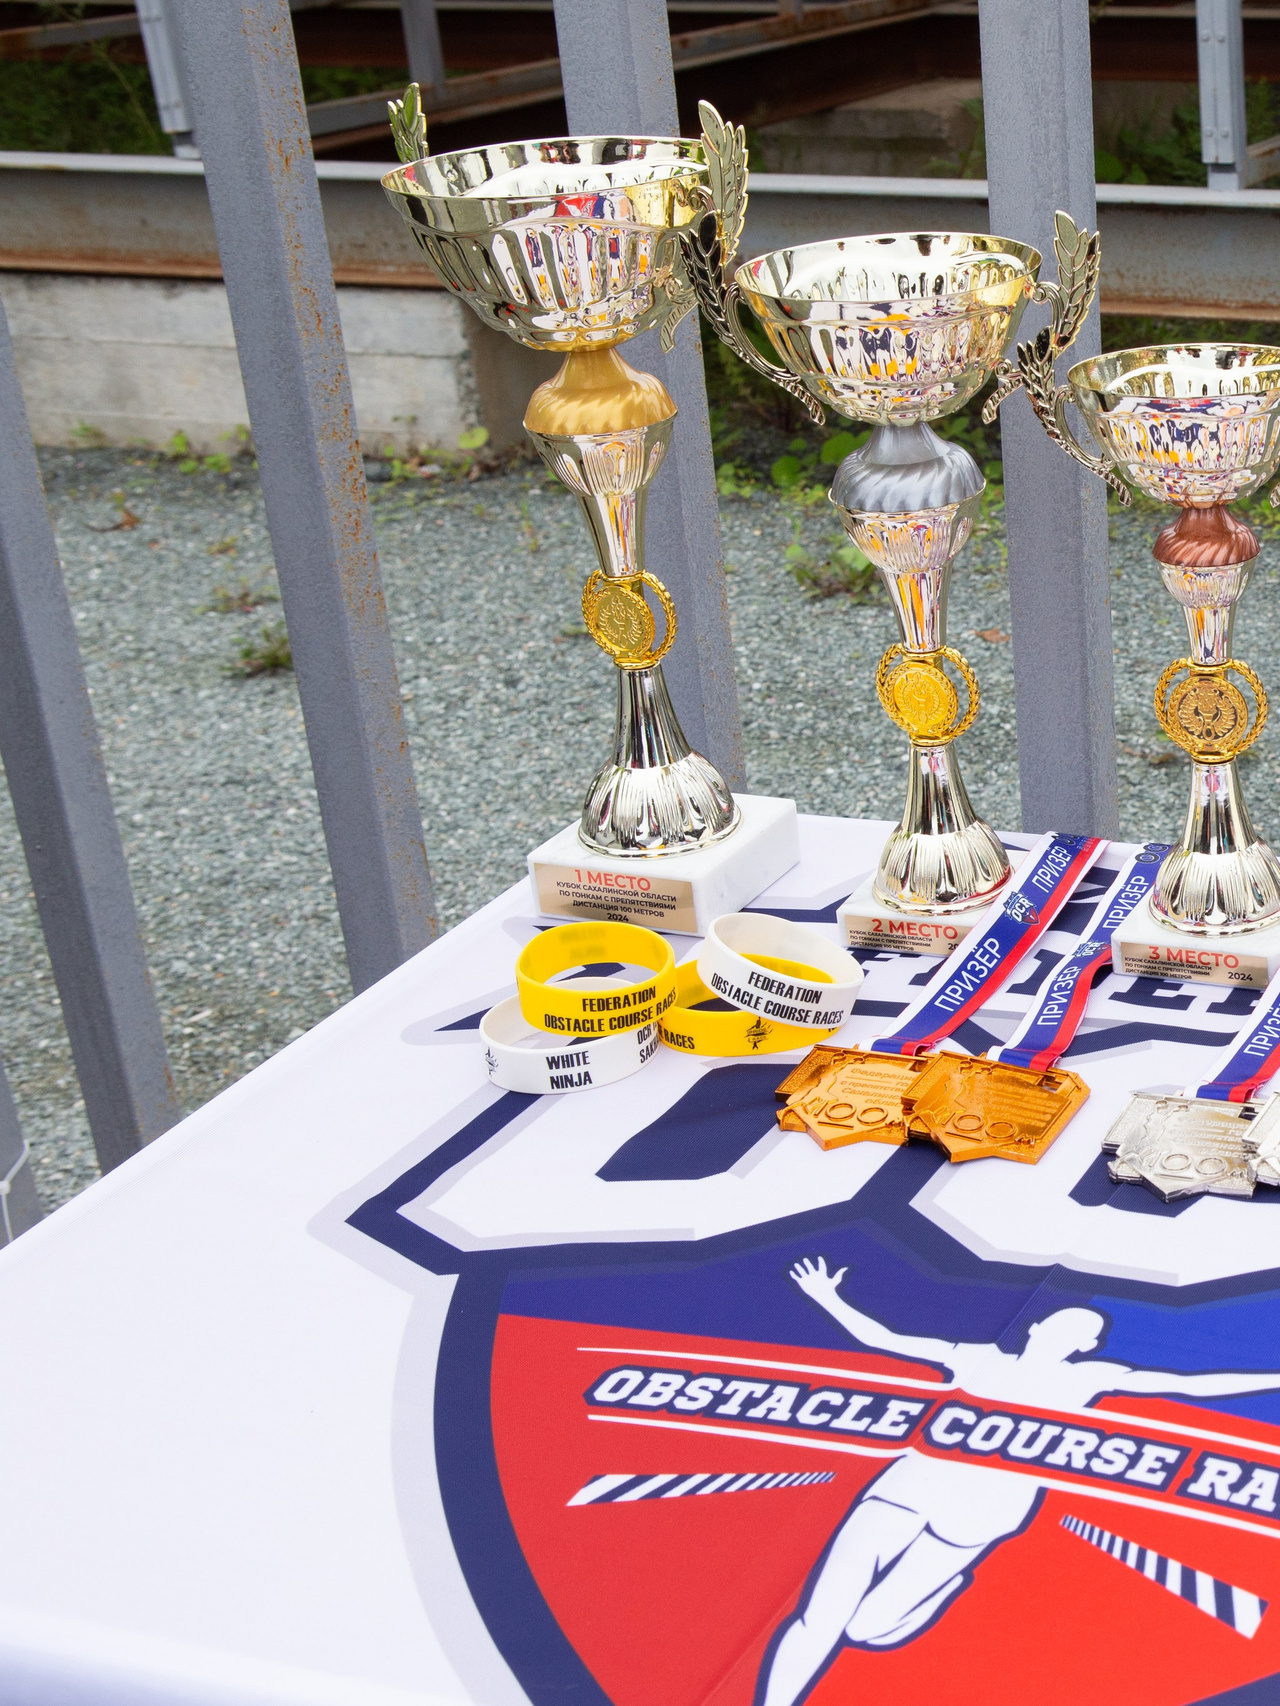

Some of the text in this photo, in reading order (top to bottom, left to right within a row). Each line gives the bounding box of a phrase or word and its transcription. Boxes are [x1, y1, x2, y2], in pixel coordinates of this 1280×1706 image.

[574, 869, 651, 891] 1 МЕСТО
[1032, 845, 1072, 893] ПРИЗЁР
[556, 881, 677, 902] КУБОК САХАЛИНСКОЙ ОБЛАСТИ
[559, 889, 570, 897] ПО
[572, 891, 603, 901] ГОНКАМ
[611, 896, 676, 910] ПРЕПЯТСТВИЯМИ
[1102, 875, 1149, 929] ПРИЗЁР
[572, 900, 665, 918] ДИСТАНЦИЯ 100 МЕТРОВ
[607, 913, 629, 922] 2024
[1011, 897, 1034, 922] OCR
[872, 918, 958, 940] 2 МЕСТО
[1148, 946, 1239, 969] 3 МЕСТО
[934, 938, 1001, 1012] ПРИЗЁР
[1227, 972, 1253, 981] 2024
[582, 986, 656, 1012] FEDERATION
[711, 972, 844, 1025] OBSTACLE COURSE RACES
[748, 971, 823, 1004] FEDERATION
[1037, 966, 1081, 1026] ПРИЗЁР
[544, 1013, 605, 1033] OBSTACLE
[609, 1006, 653, 1031] COURSE
[656, 987, 676, 1016] RACES
[664, 1028, 695, 1050] RACES
[546, 1051, 590, 1070] WHITE
[550, 1071, 593, 1090] NINJA
[590, 1367, 928, 1438] OBSTACLE
[928, 1405, 1182, 1487] COURSE
